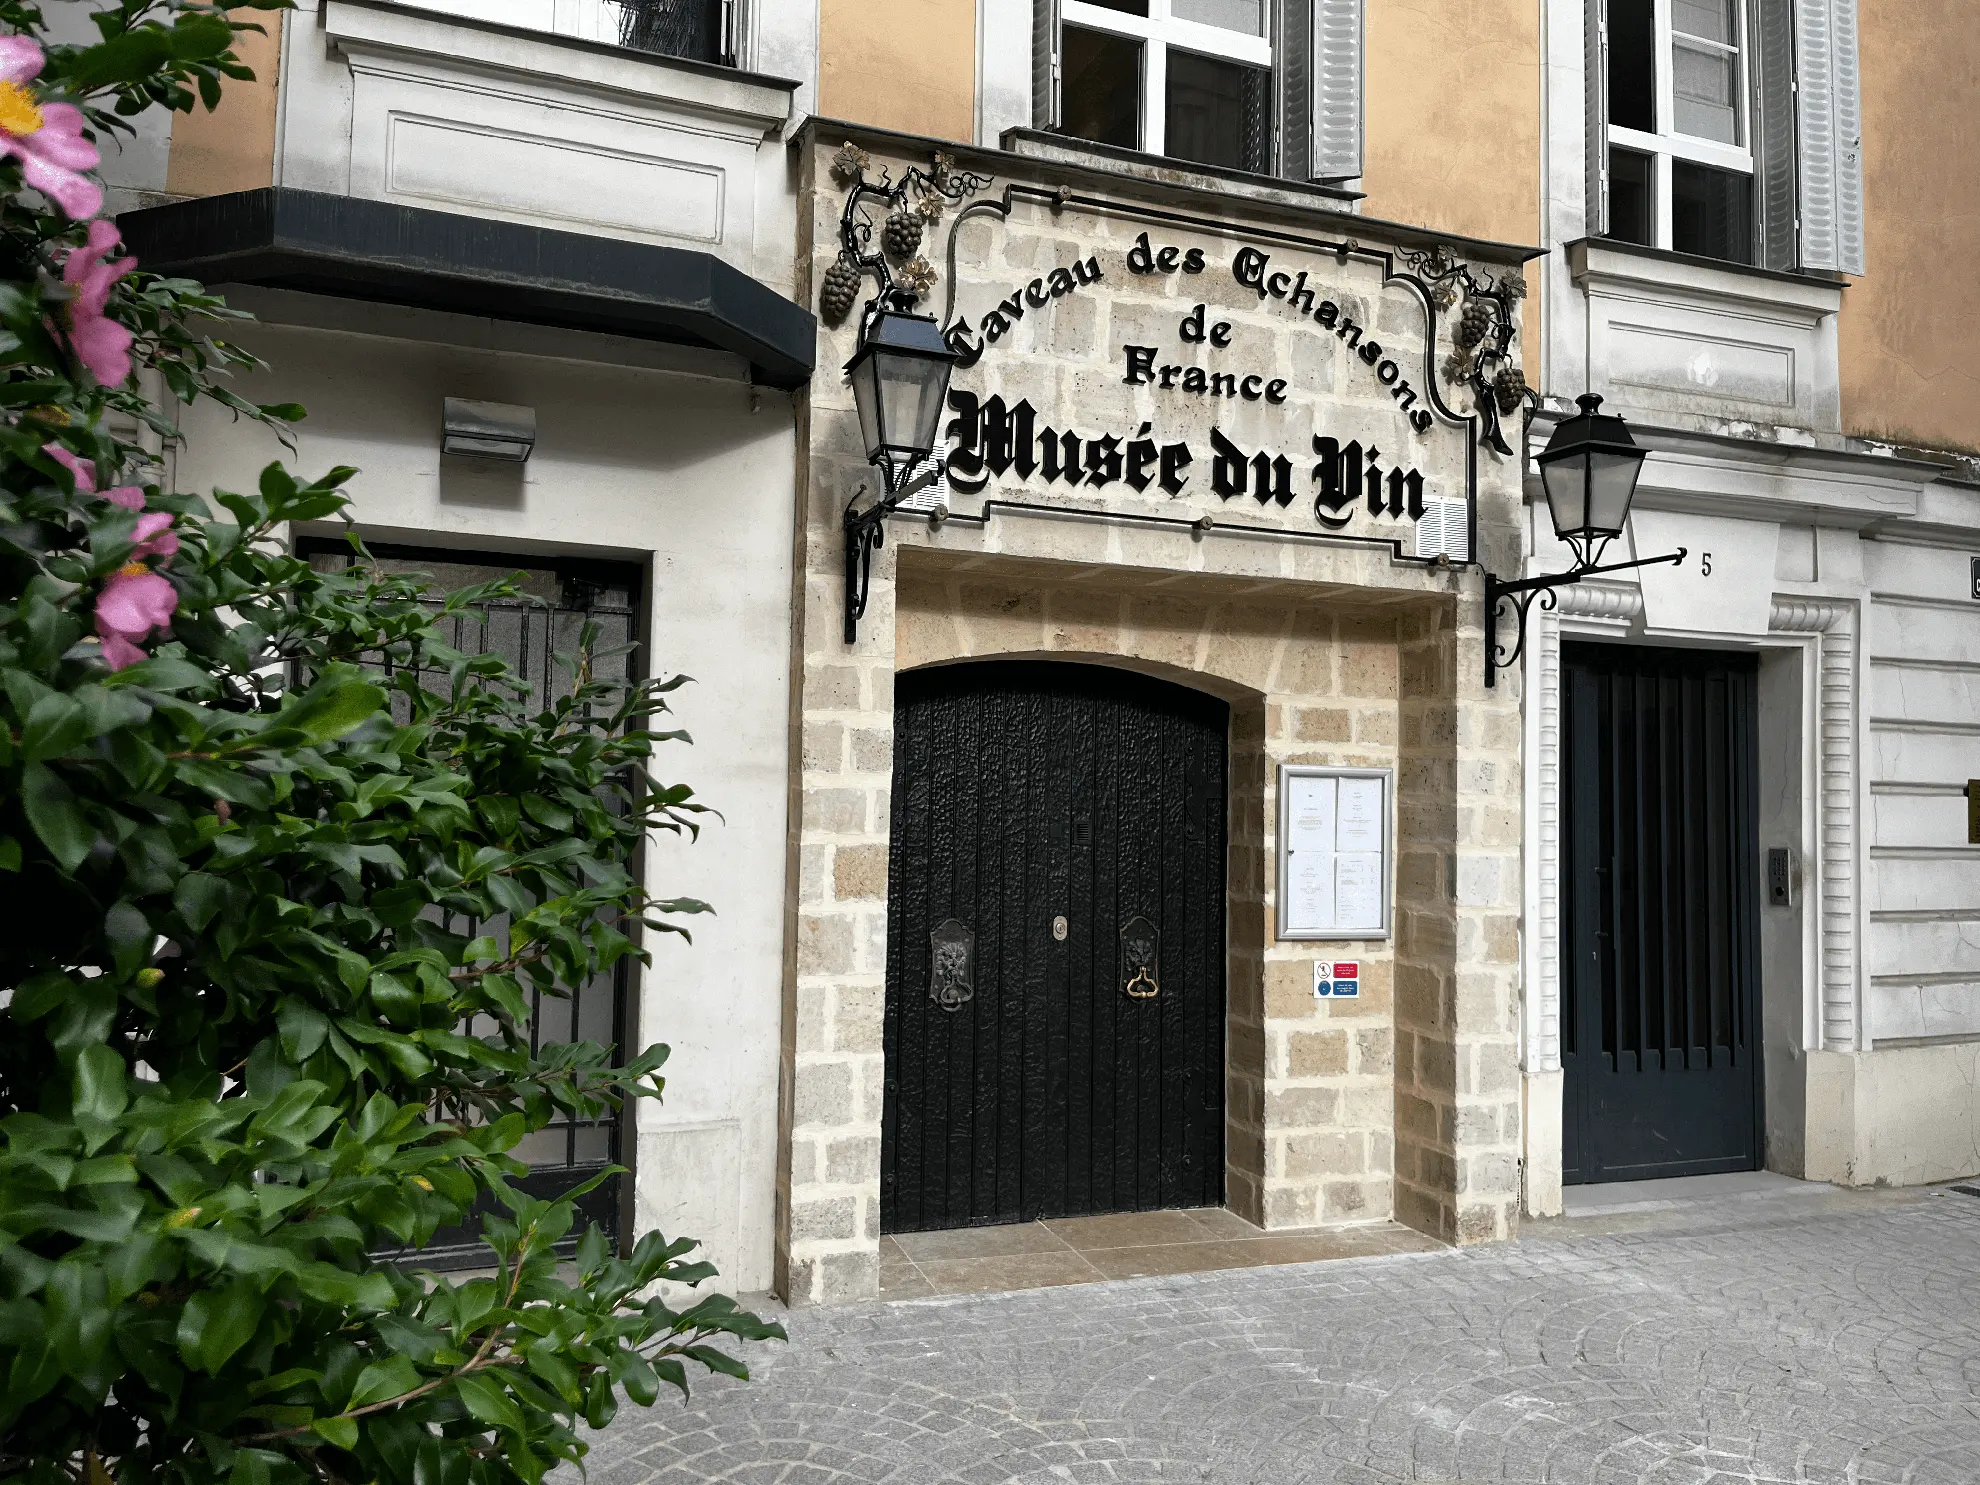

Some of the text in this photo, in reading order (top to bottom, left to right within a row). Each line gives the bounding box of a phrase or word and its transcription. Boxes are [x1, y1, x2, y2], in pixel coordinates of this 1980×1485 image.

[949, 231, 1433, 434] Caveau des Echansons
[1179, 303, 1232, 348] de
[1121, 344, 1288, 405] France
[946, 386, 1429, 529] Musée du Vin
[1701, 552, 1712, 577] 5
